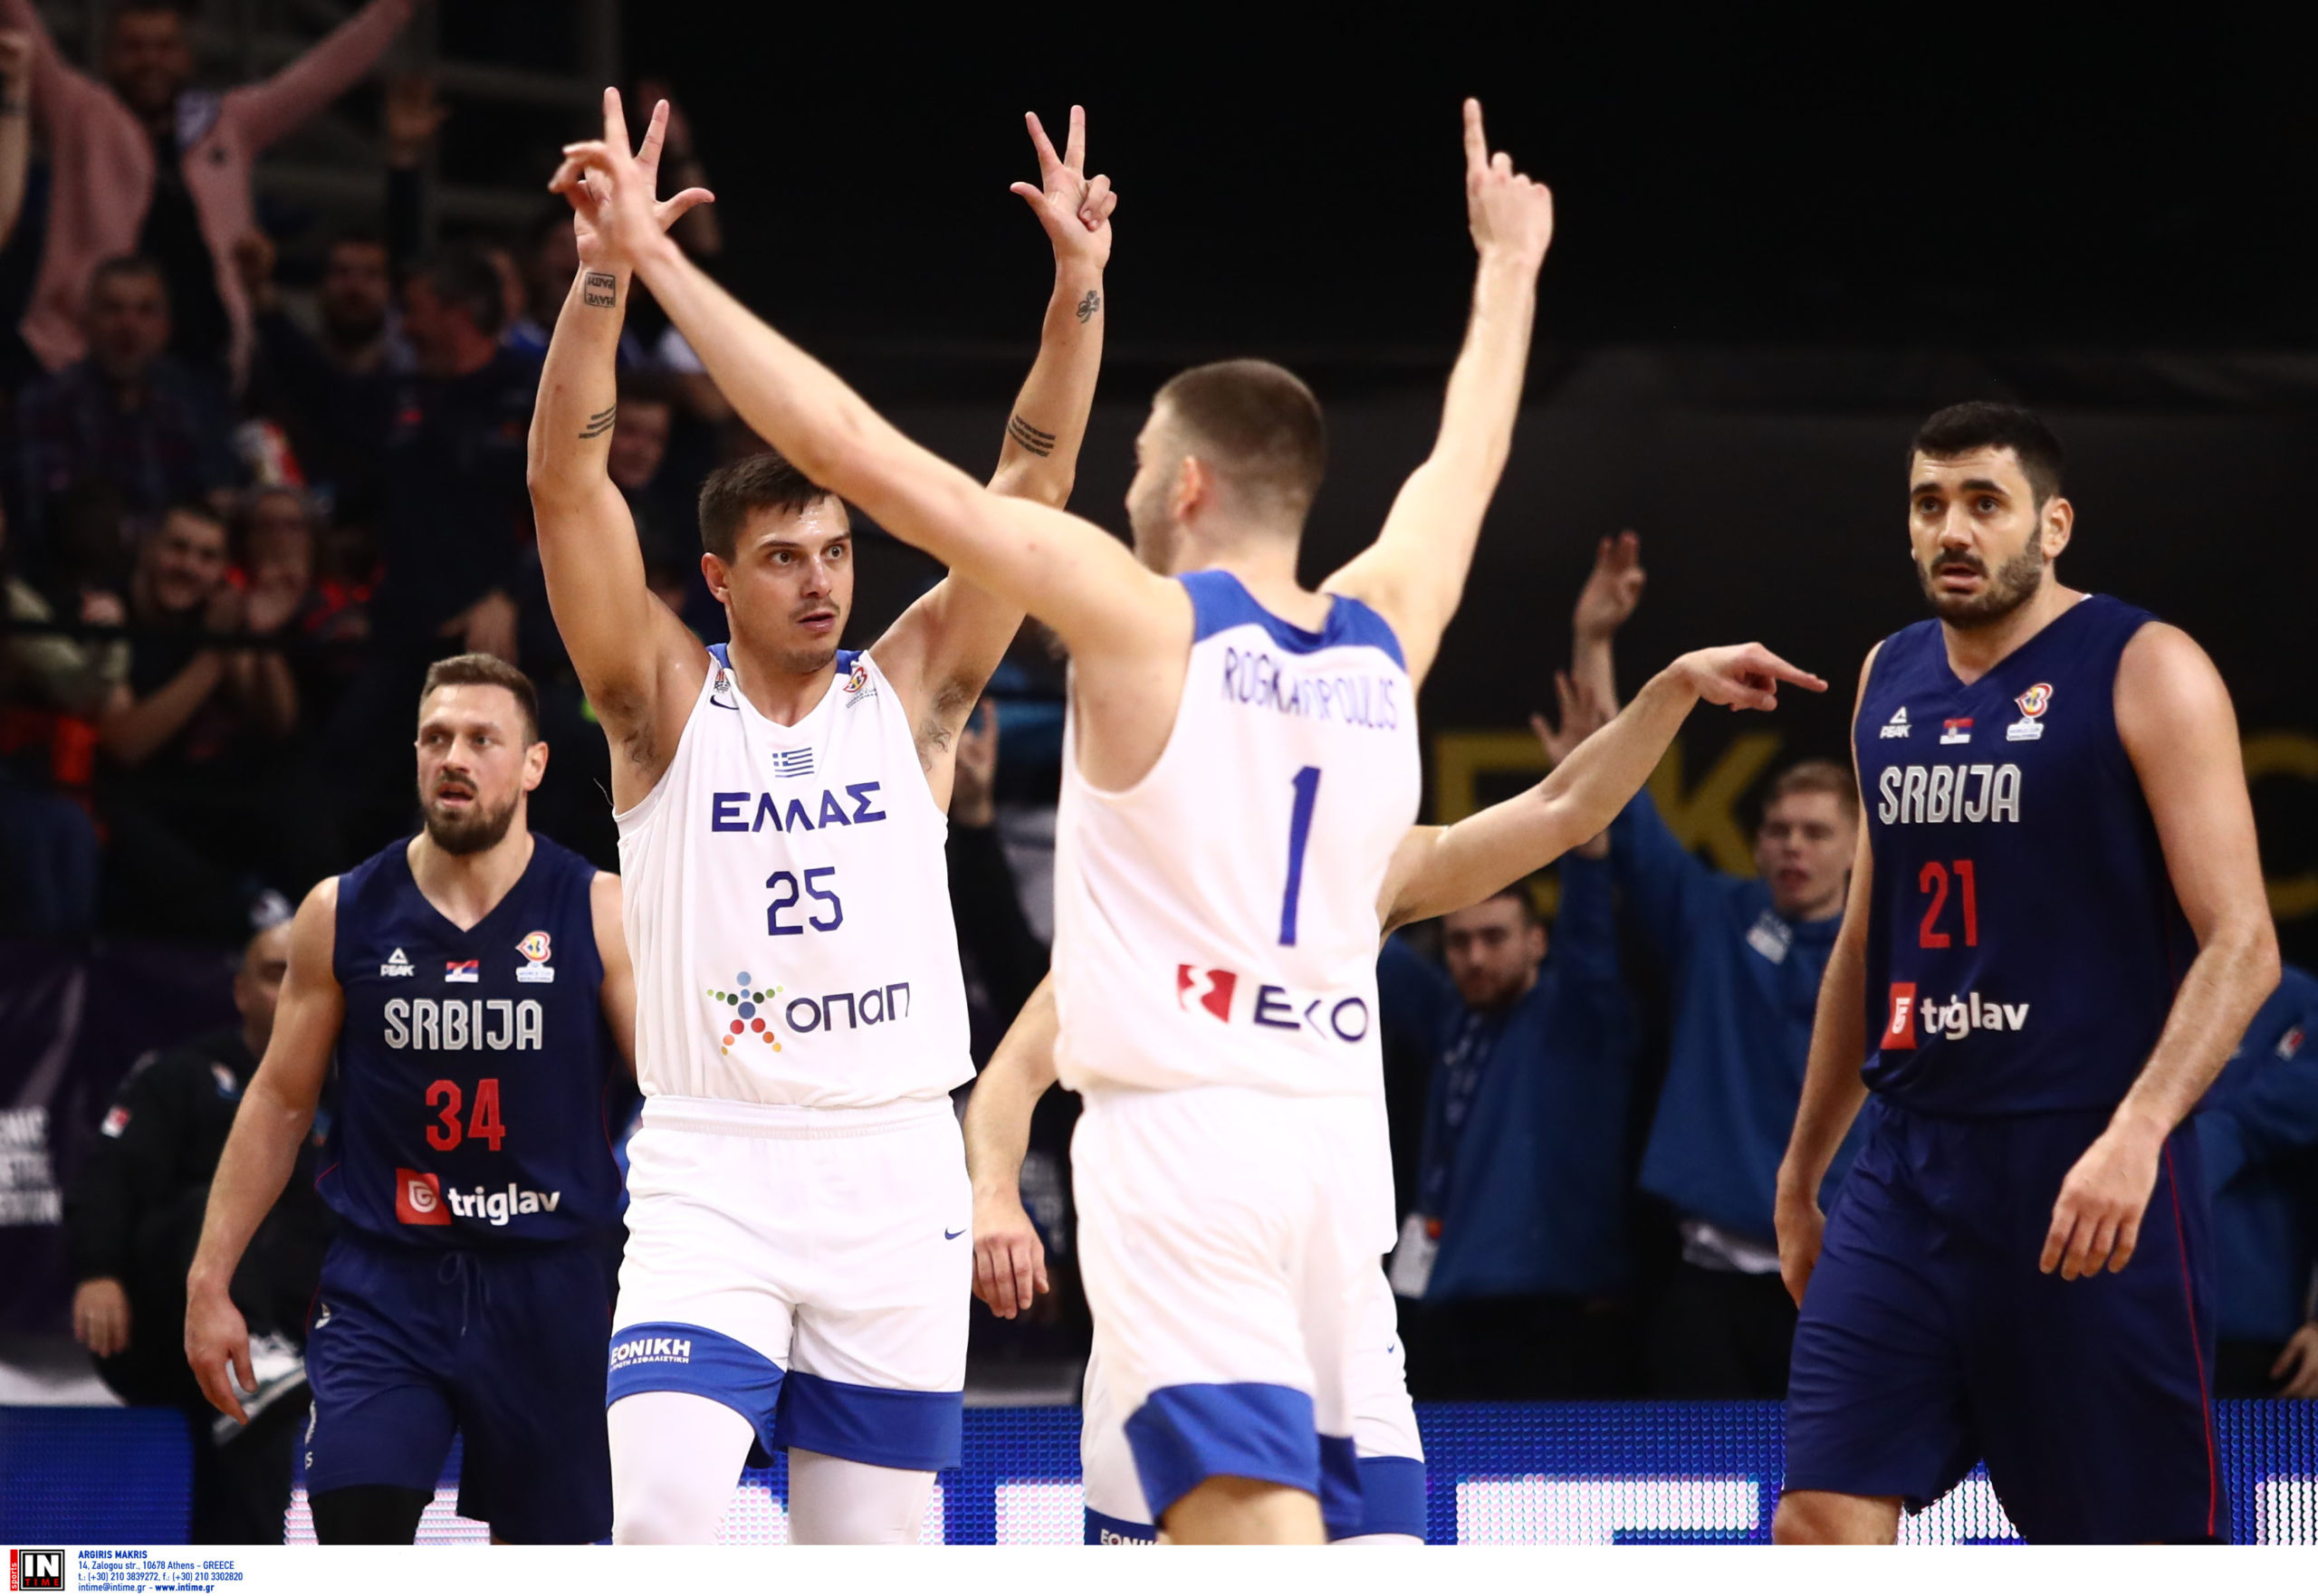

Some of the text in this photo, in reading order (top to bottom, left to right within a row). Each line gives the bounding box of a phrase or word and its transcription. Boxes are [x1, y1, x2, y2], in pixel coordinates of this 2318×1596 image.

[588, 293, 614, 306] HAVE
[1879, 723, 1912, 739] PEAK
[711, 780, 886, 834] ΕΛΛΑΣ
[1879, 763, 2022, 825] SRBIJA
[1279, 766, 1321, 946] 1
[765, 866, 844, 936] 25
[1919, 859, 1978, 949] 21
[380, 964, 415, 977] PEAK
[384, 998, 544, 1051] SRBIJA
[1920, 992, 2030, 1040] triglav
[425, 1078, 506, 1152] 34
[447, 1183, 560, 1227] triglav
